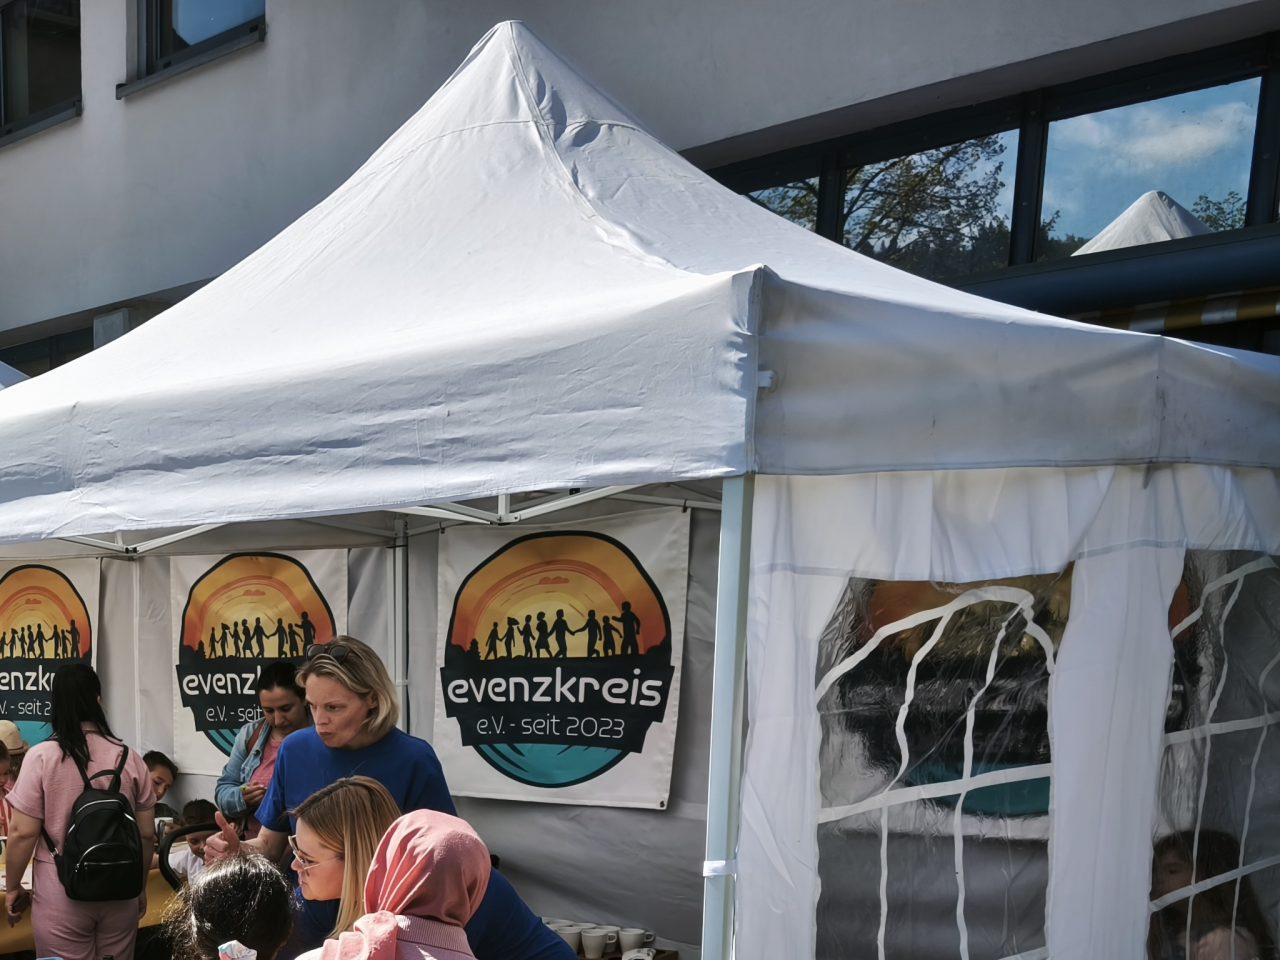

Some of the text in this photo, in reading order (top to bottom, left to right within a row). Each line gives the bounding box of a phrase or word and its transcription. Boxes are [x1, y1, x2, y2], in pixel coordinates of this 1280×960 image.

[446, 666, 663, 707] evenzkreis
[17, 698, 42, 715] seit
[205, 705, 227, 722] e.V.
[237, 703, 263, 722] seit
[476, 715, 506, 735] e.V.
[521, 713, 561, 736] seit
[566, 716, 625, 739] 2023
